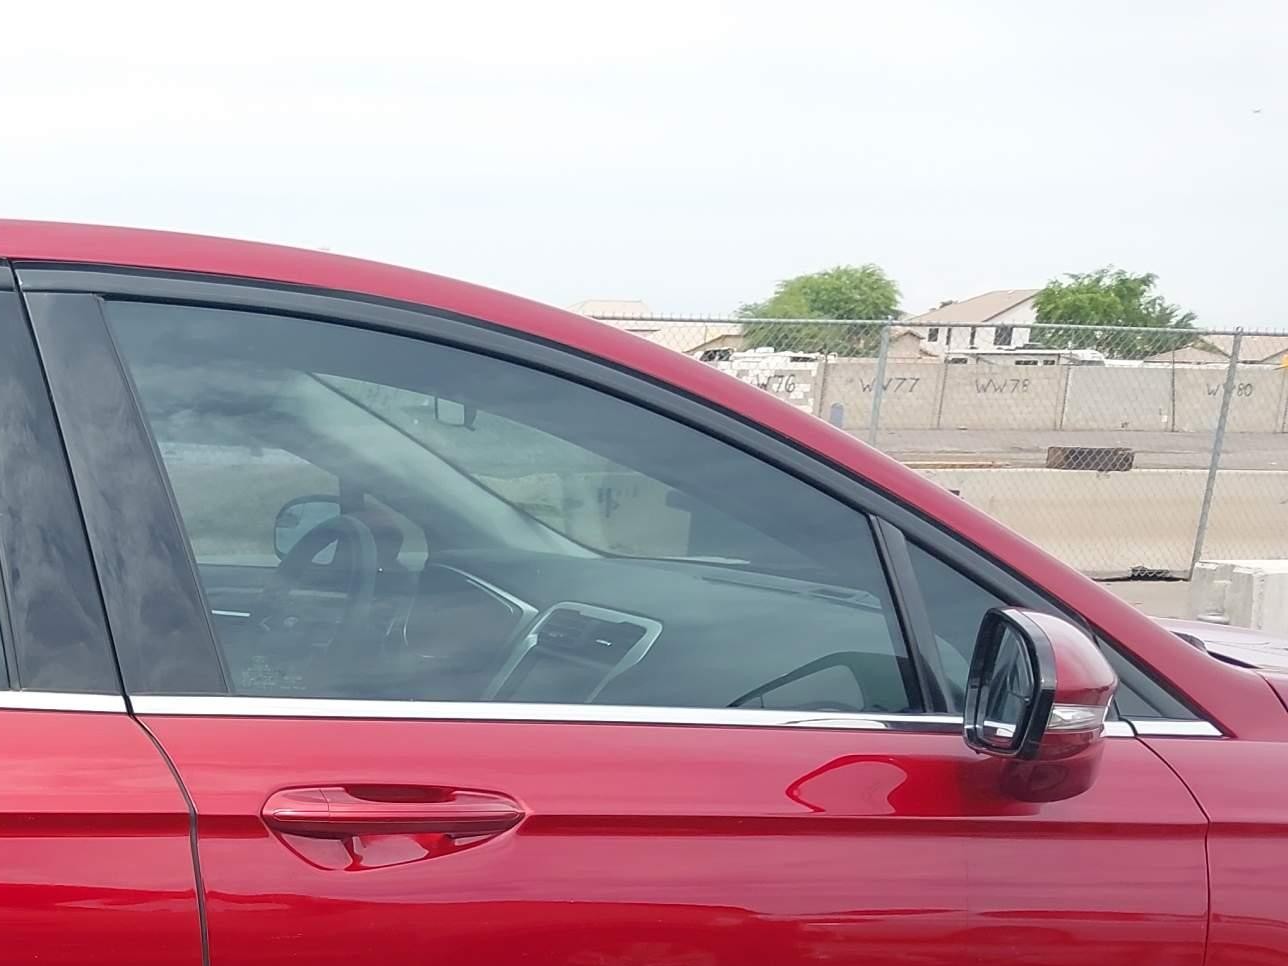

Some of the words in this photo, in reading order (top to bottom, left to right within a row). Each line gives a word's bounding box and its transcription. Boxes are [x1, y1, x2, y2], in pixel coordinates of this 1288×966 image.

[737, 373, 797, 394] W76
[975, 378, 1030, 393] WW78
[1206, 382, 1253, 397] W80
